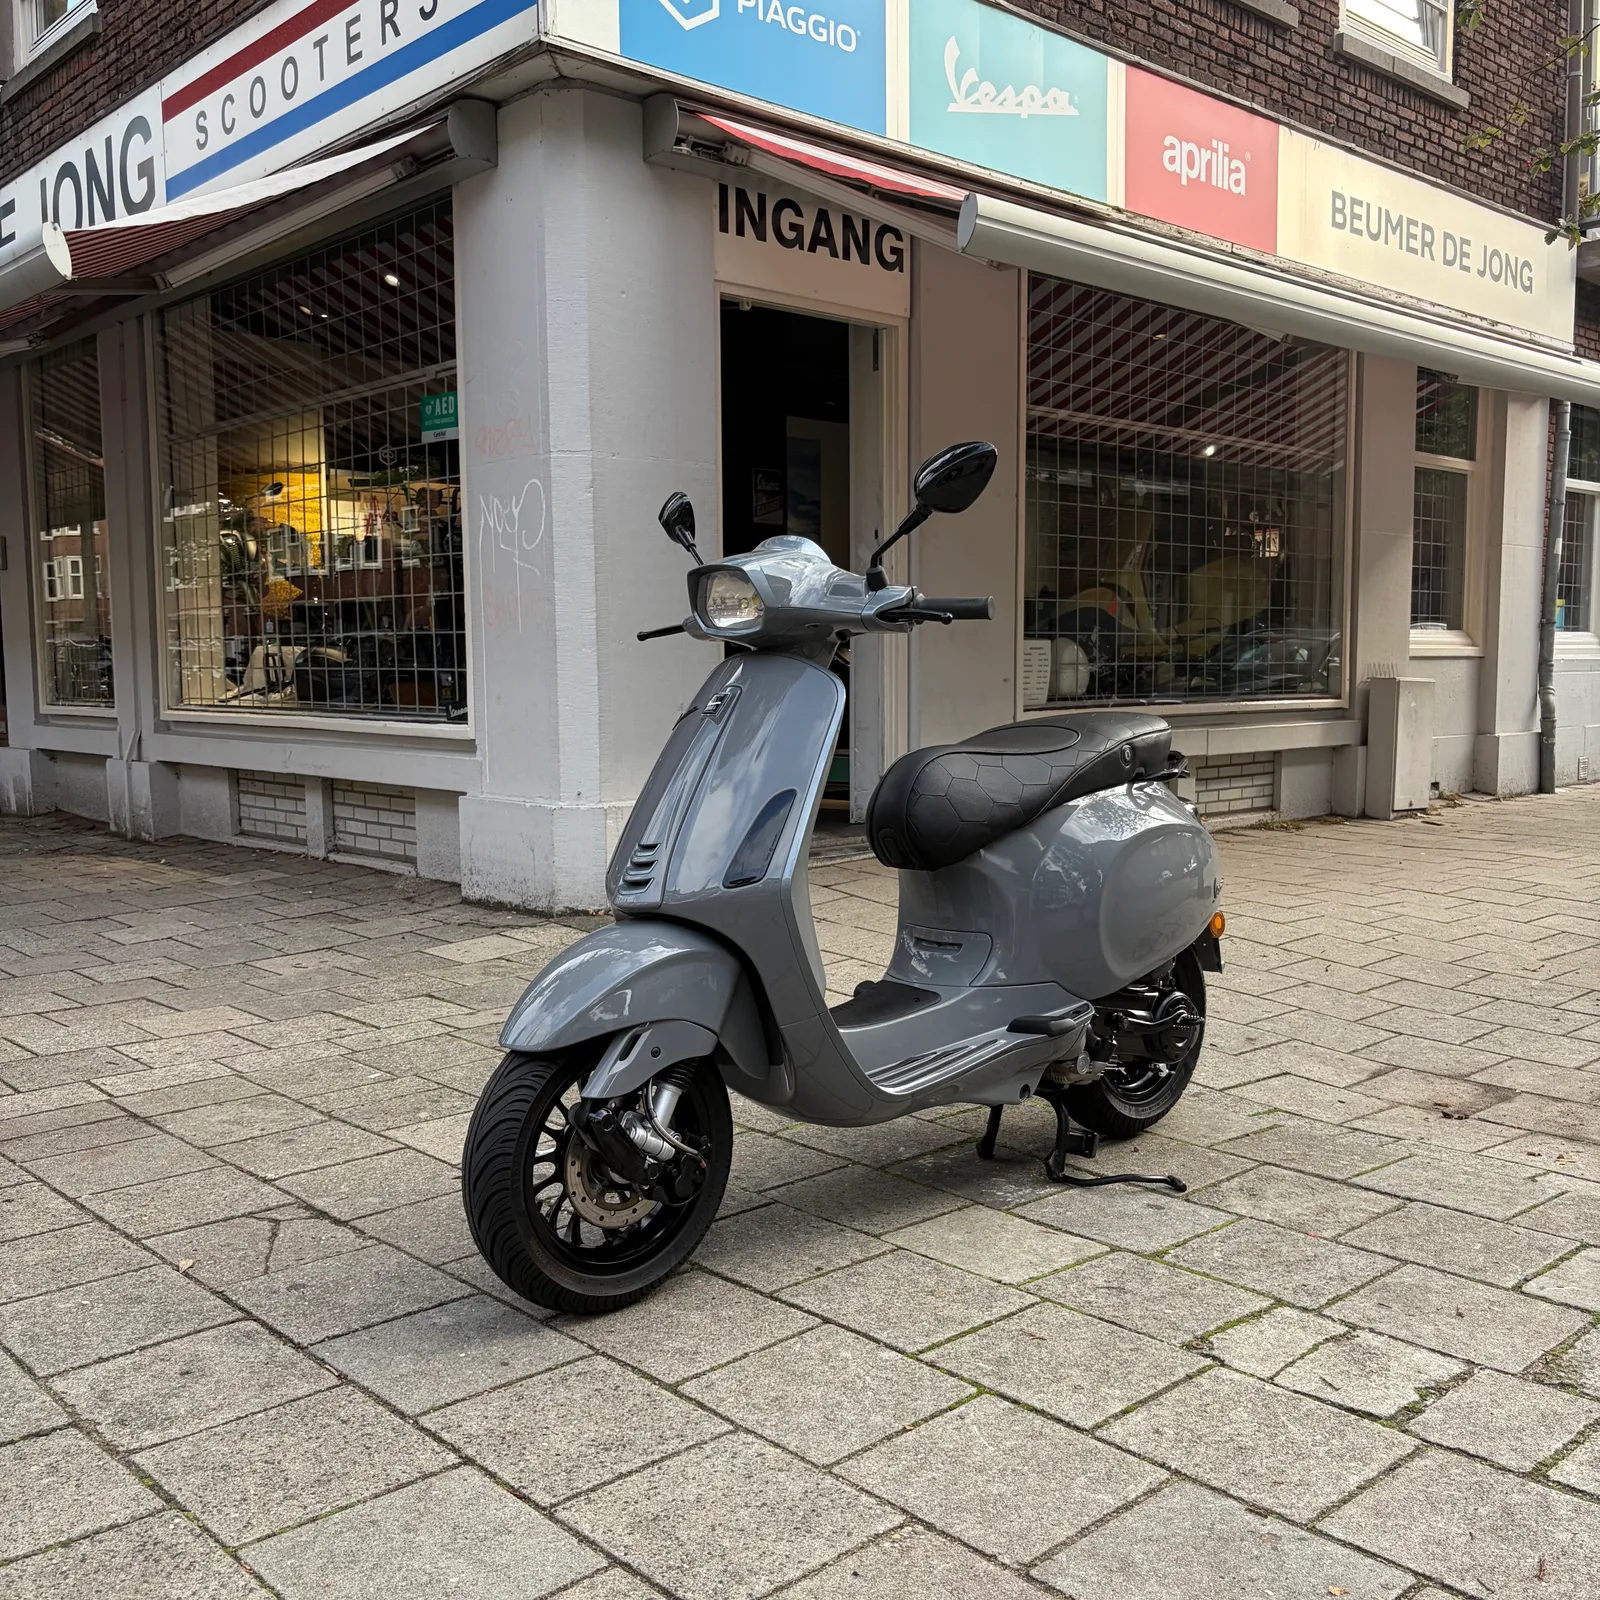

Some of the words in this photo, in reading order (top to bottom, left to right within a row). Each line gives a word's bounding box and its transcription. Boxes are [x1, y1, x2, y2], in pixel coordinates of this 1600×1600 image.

[944, 36, 1080, 118] Vespa
[1163, 134, 1246, 196] aprilia
[718, 182, 905, 274] INGANG
[1331, 190, 1436, 262] BEUMER
[1442, 231, 1472, 274] DE
[1476, 249, 1534, 295] JONG
[434, 395, 455, 416] AED
